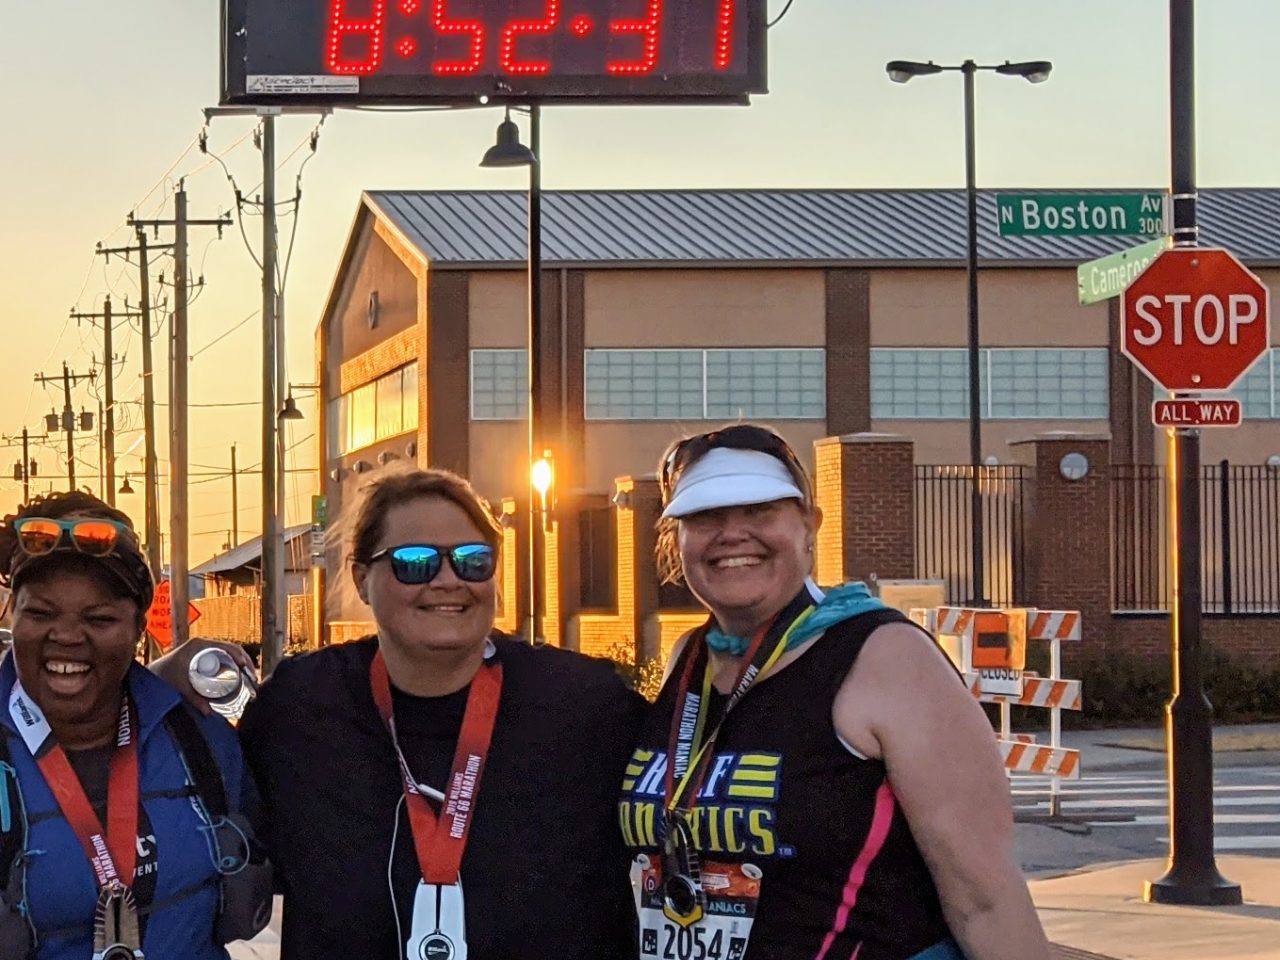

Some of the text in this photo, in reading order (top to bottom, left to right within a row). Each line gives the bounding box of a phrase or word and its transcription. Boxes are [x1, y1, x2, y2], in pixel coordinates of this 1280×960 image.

[1001, 205, 1013, 224] N
[1022, 199, 1127, 230] Boston
[1133, 293, 1258, 346] STOP
[1161, 405, 1234, 422] ALL WAY
[677, 692, 701, 741] MARATHON
[449, 772, 464, 800] WILLIAMS
[449, 754, 482, 839] ROUTE 66 MARATHON
[90, 833, 117, 878] MARATHON
[132, 861, 159, 879] ENT
